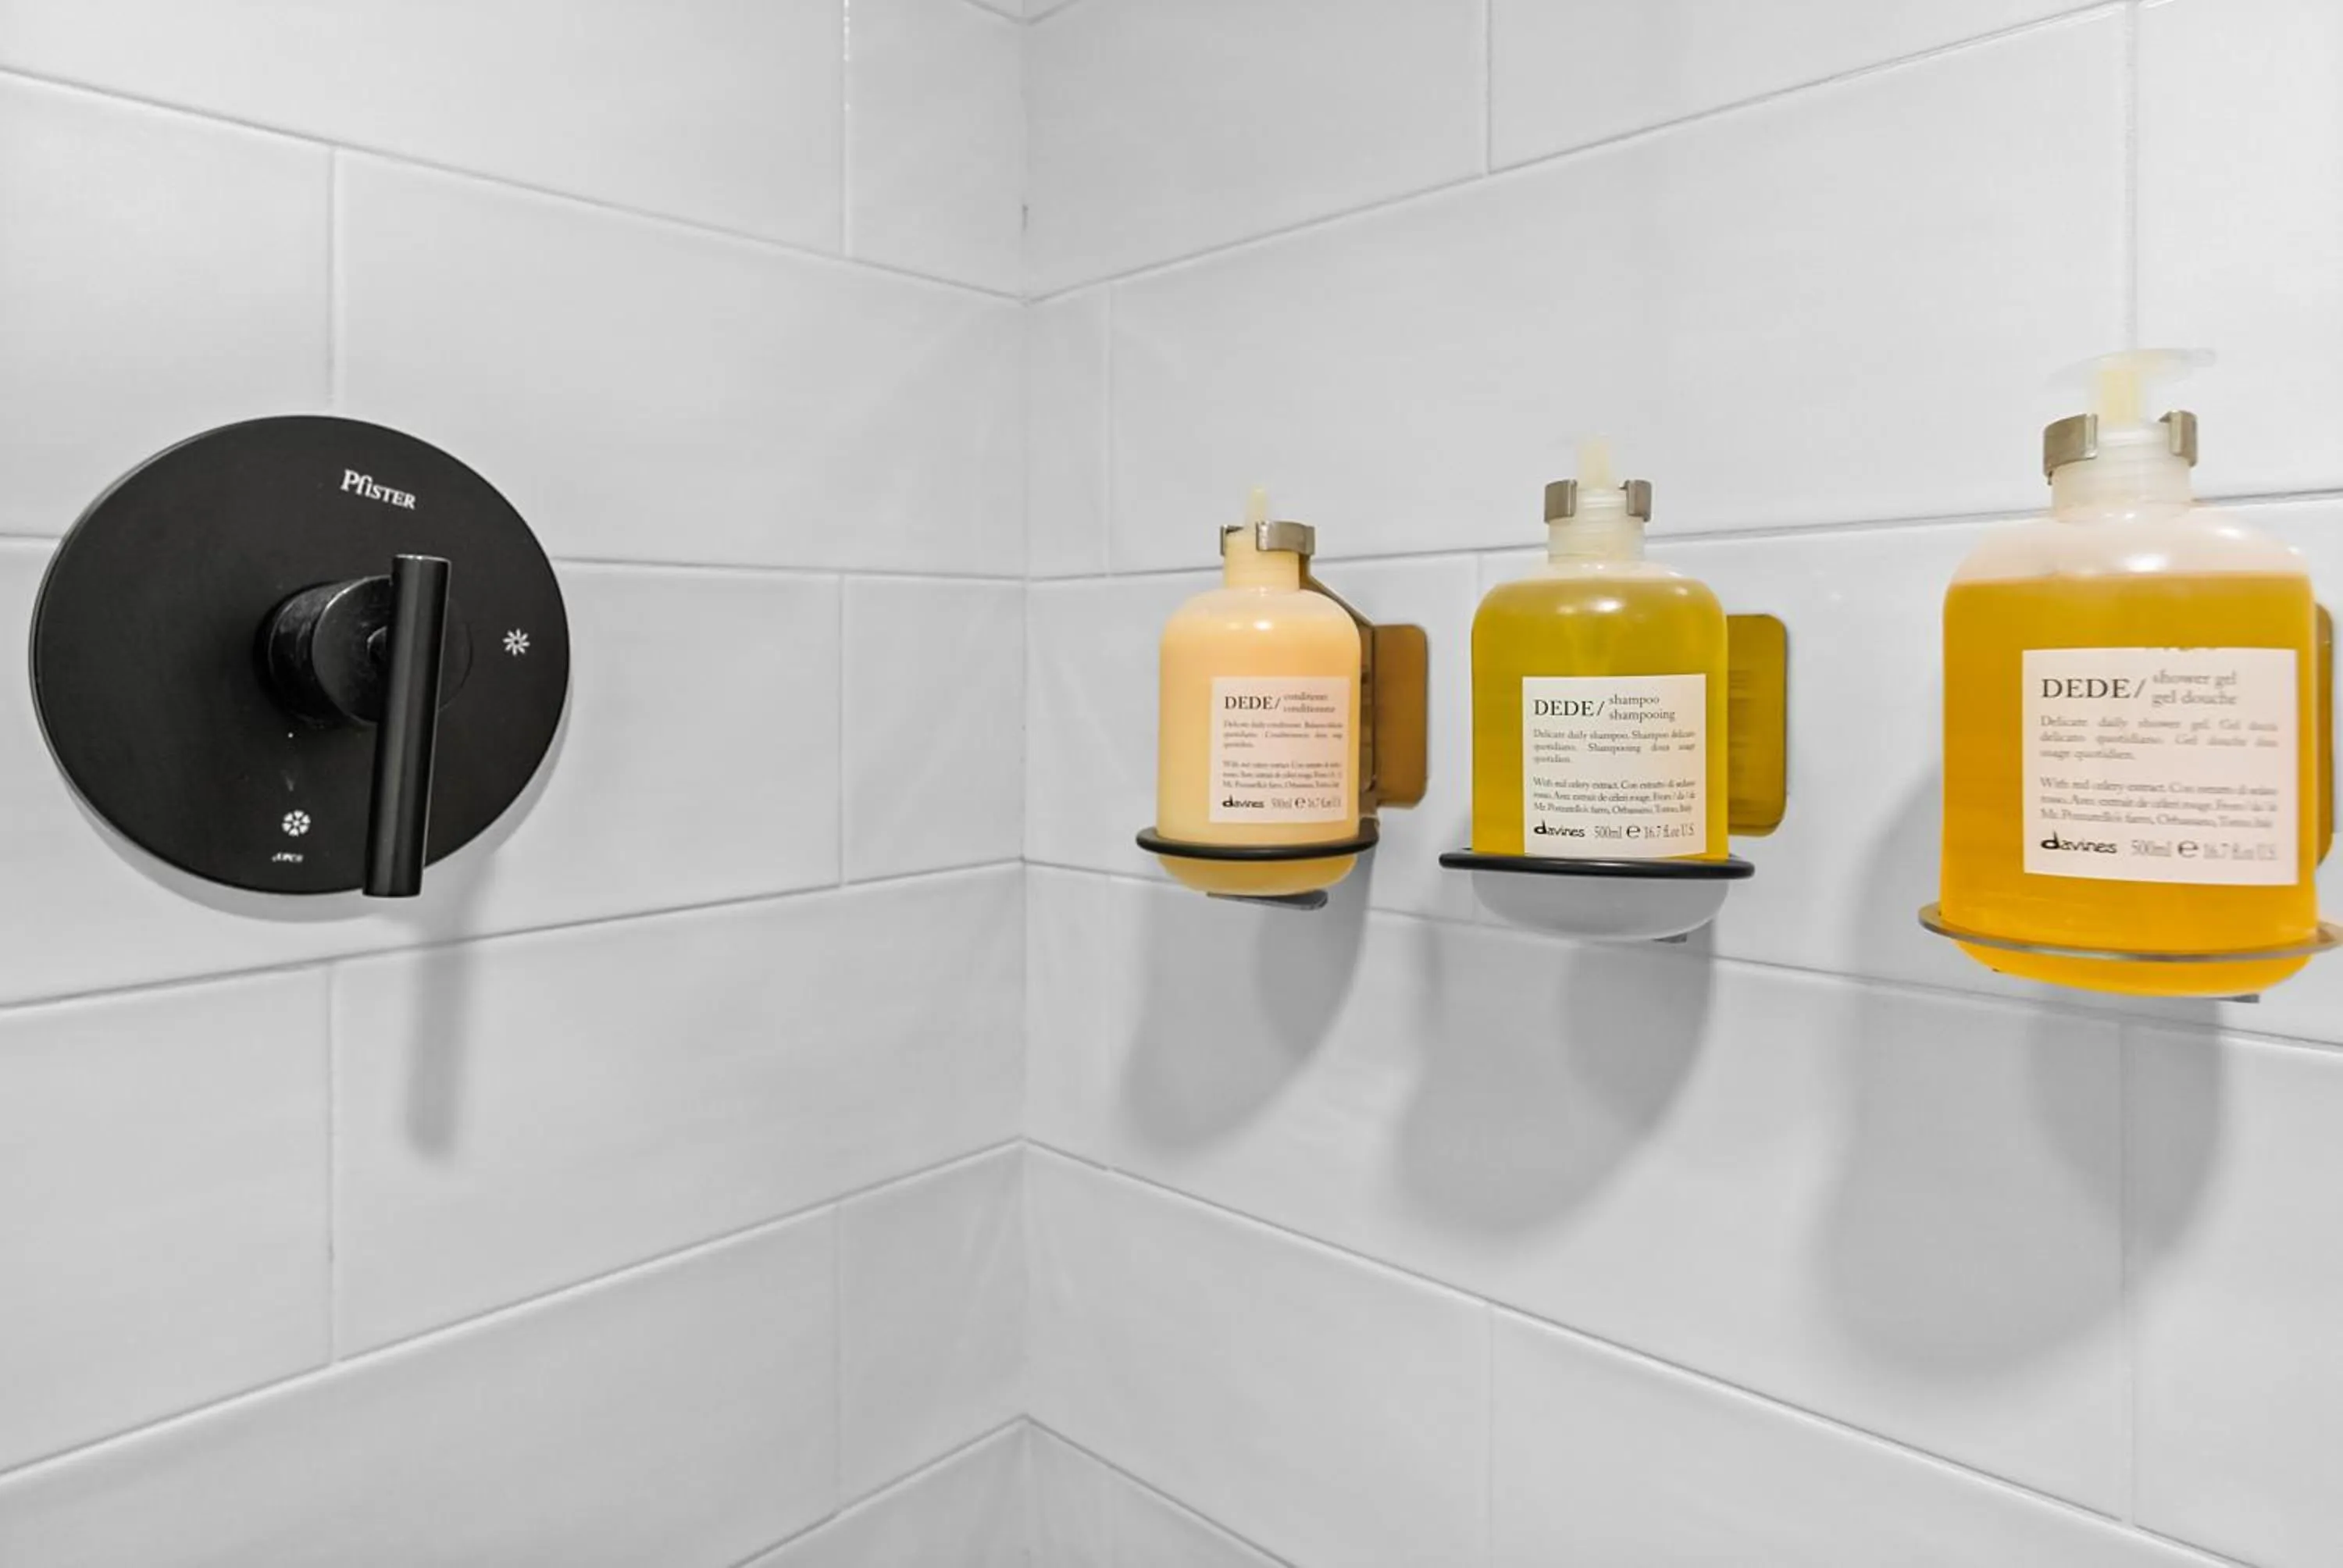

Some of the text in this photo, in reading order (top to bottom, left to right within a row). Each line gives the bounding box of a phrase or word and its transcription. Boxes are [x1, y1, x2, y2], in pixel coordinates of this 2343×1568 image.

[2152, 668, 2238, 690] shower gel
[1609, 693, 1660, 707] shampoo
[2152, 690, 2238, 707] gel douche
[1609, 708, 1676, 723] shampooing
[1221, 794, 1264, 809] davines
[1533, 819, 1585, 838] davines
[2039, 830, 2117, 854] davines
